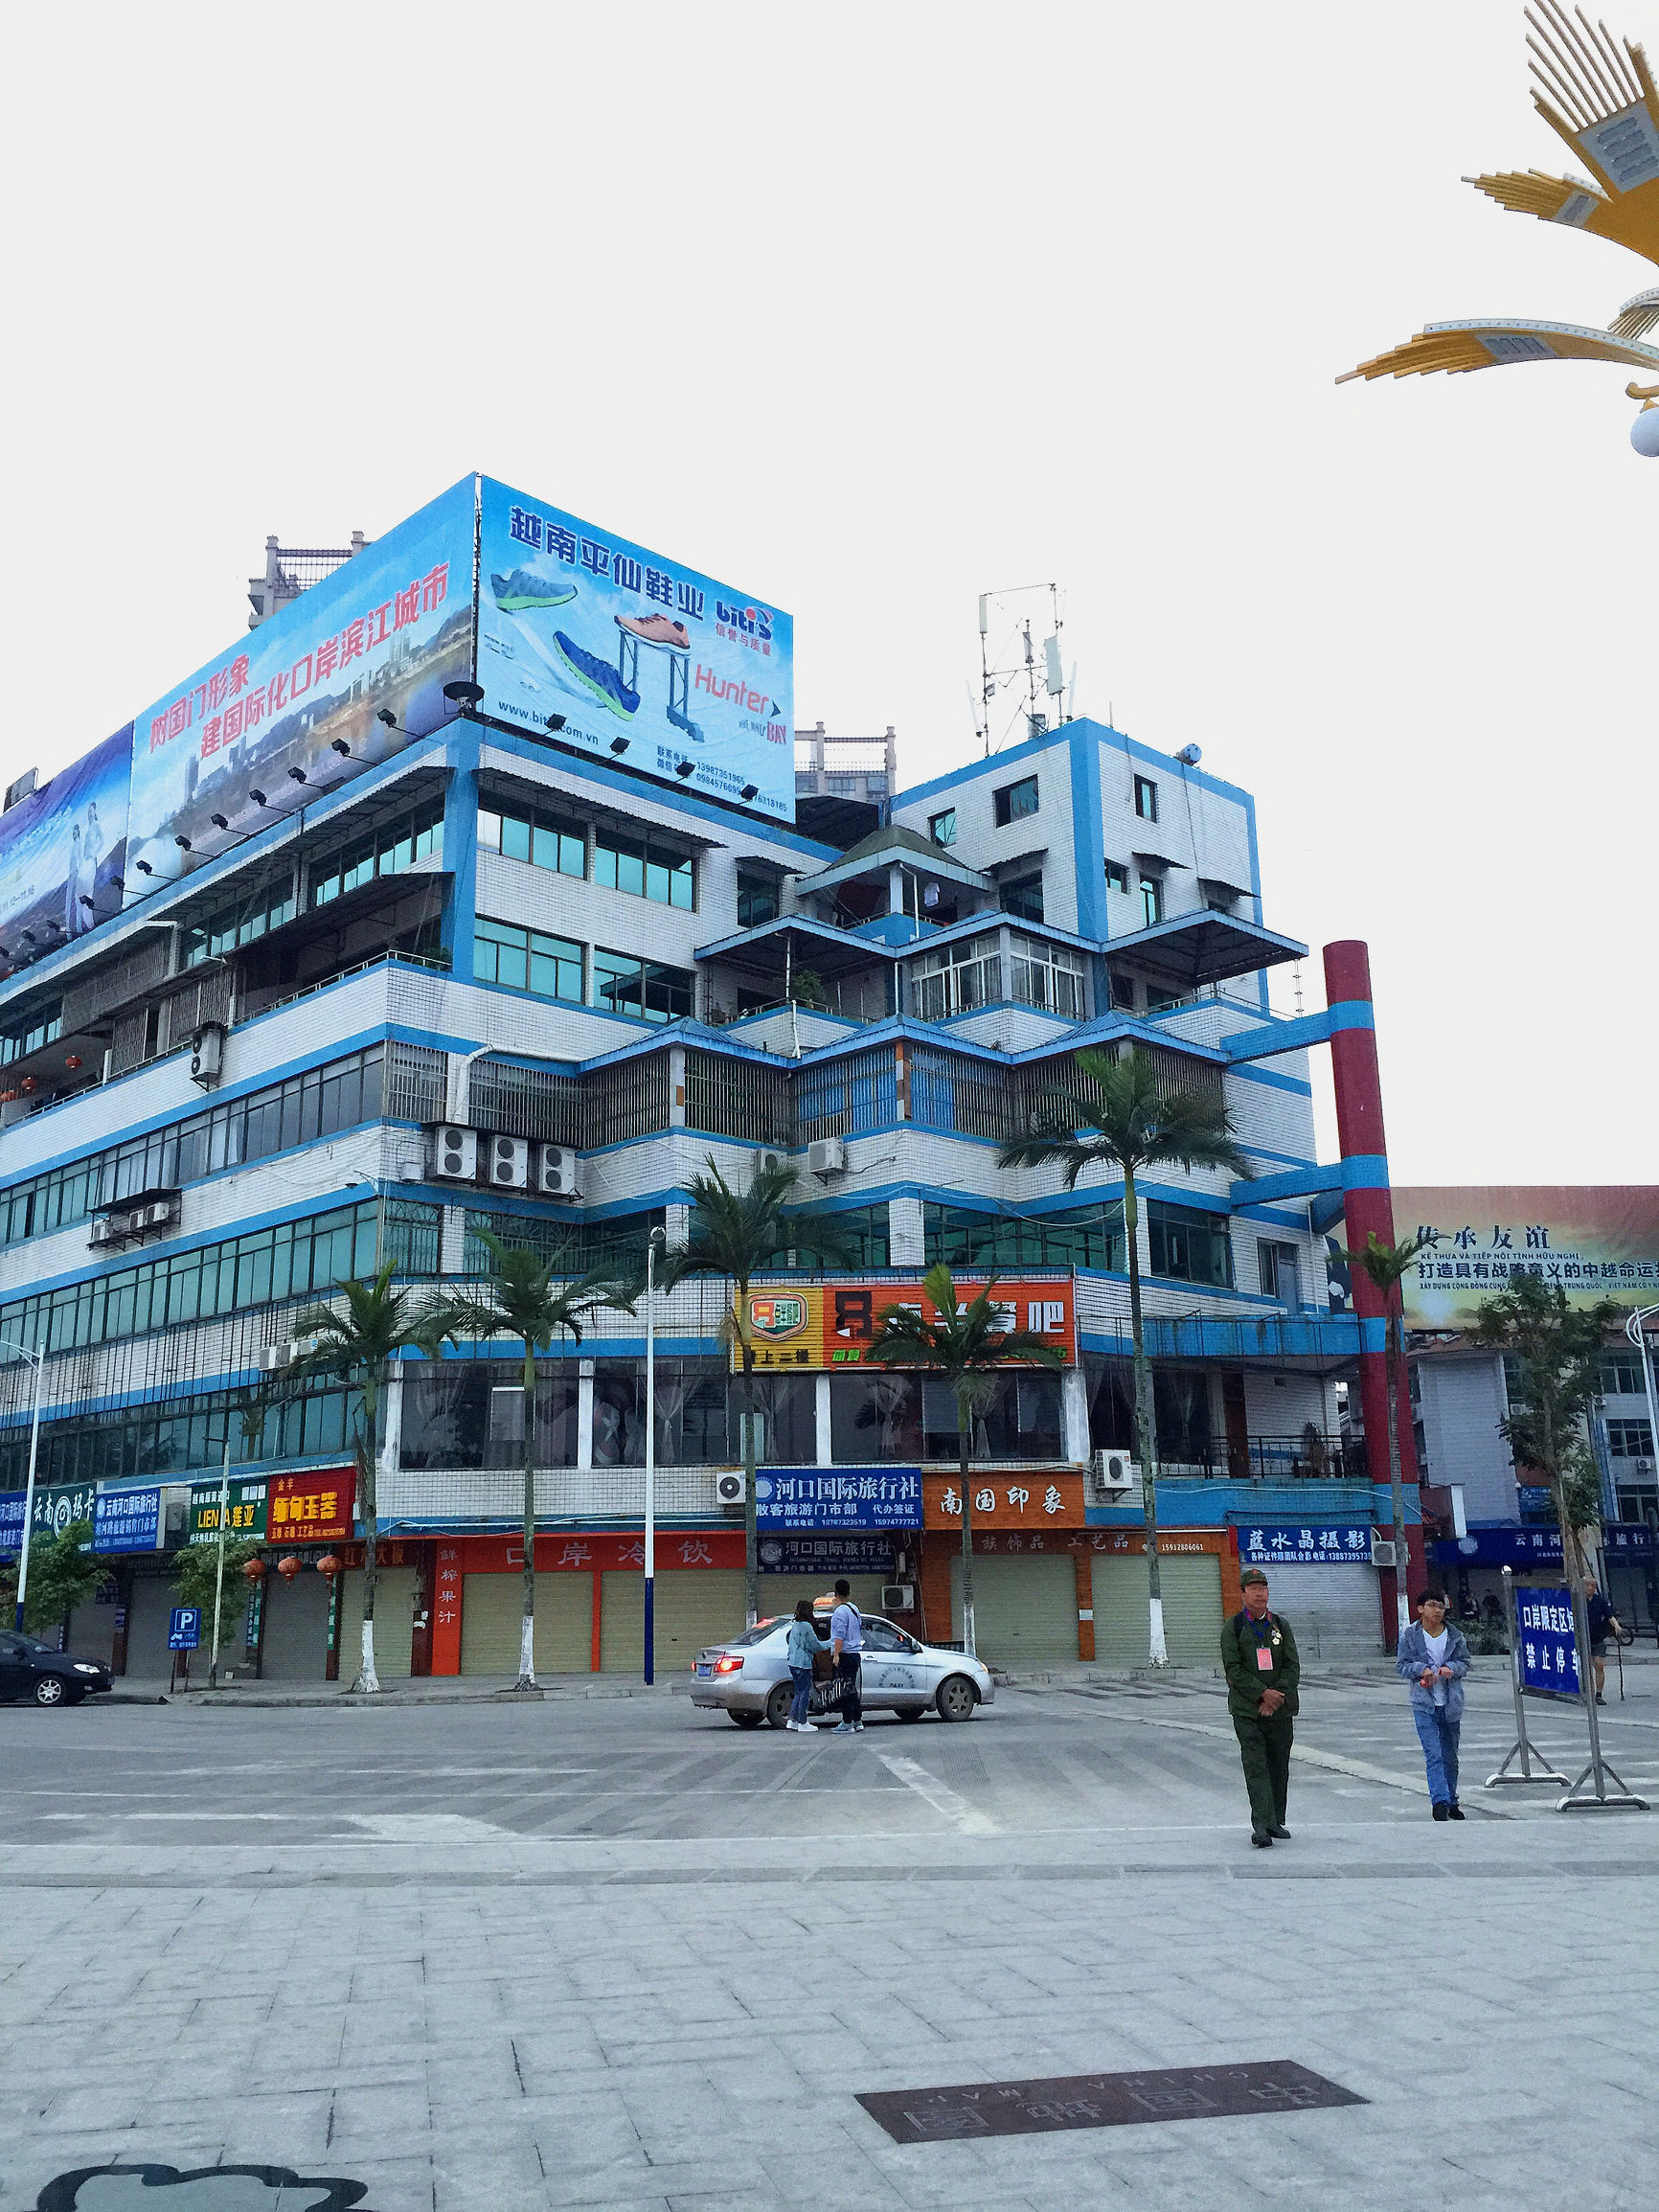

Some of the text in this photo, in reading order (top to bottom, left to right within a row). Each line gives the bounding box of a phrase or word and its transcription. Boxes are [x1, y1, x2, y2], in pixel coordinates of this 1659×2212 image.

[511, 506, 704, 622] 越南平仙鞋业
[716, 622, 772, 657] 信誉与质量
[200, 561, 450, 759] 建国际化口岸滨江城市
[694, 663, 769, 715] Hunter
[149, 653, 250, 754] 树国门形象
[1418, 1261, 1659, 1279] 打造具有战略意义的中越命运
[775, 1475, 920, 1501] 河口国际旅行社
[940, 1486, 1066, 1516] 南国印象
[873, 1503, 915, 1515] 代办签证
[506, 1539, 714, 1567] 口岸冷饮
[785, 1540, 892, 1557] 河口国际旅行社
[1067, 1533, 1129, 1550] 工艺品
[1161, 1542, 1204, 1552] 15912806061
[1246, 1529, 1366, 1551] 蓝水晶摄影
[438, 1548, 459, 1624] 鲜榨果汁
[180, 1612, 193, 1630] P
